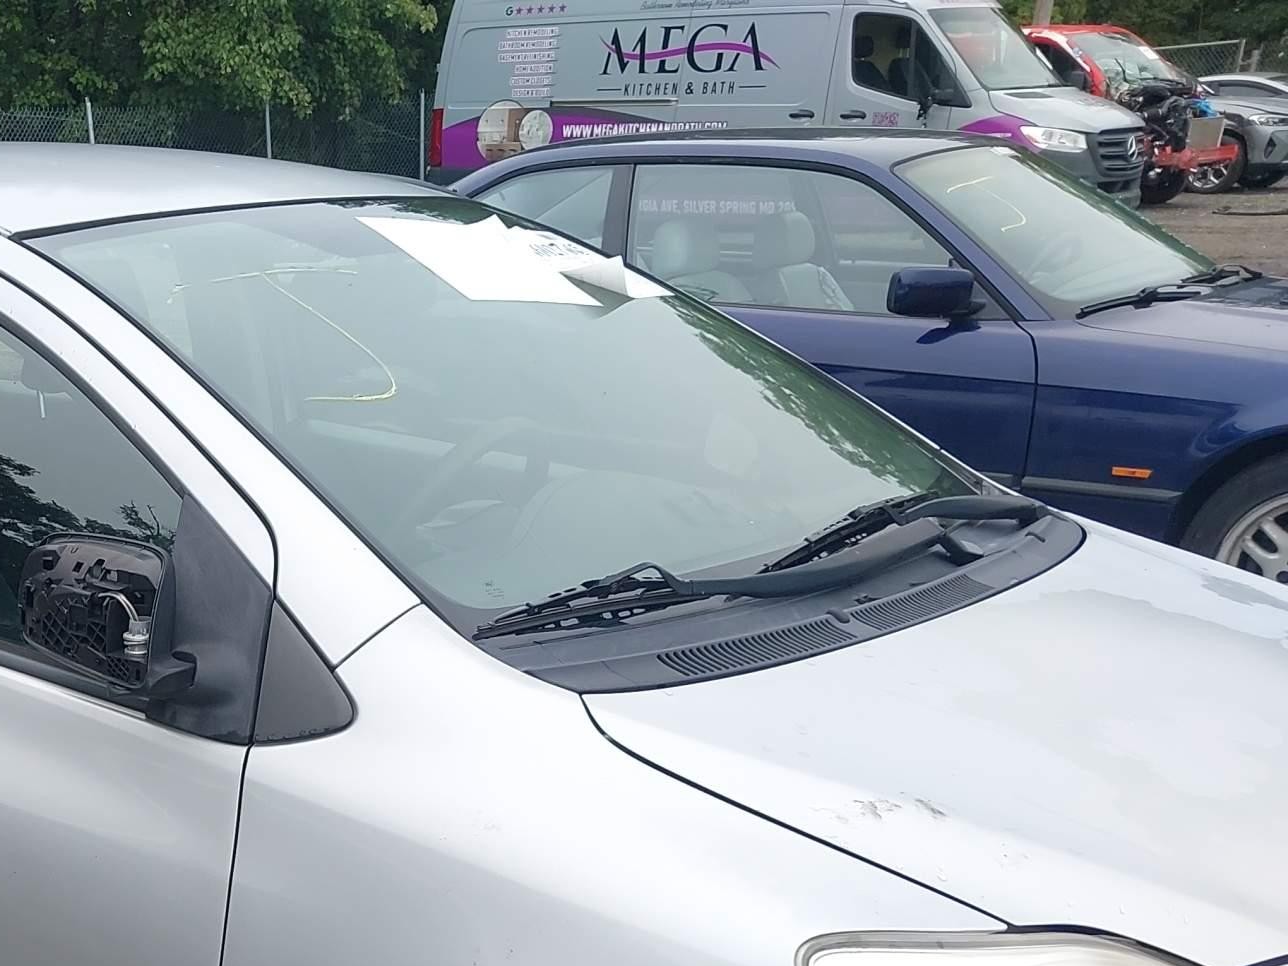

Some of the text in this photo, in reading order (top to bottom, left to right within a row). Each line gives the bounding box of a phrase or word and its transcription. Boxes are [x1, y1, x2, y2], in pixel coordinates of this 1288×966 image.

[599, 22, 768, 75] MEGA
[623, 81, 735, 96] KITCHEN & BATH
[562, 121, 727, 138] WWW.MEGAKITCHENANDBATHCOM
[683, 200, 716, 214] SILVER
[720, 200, 756, 215] SPRING
